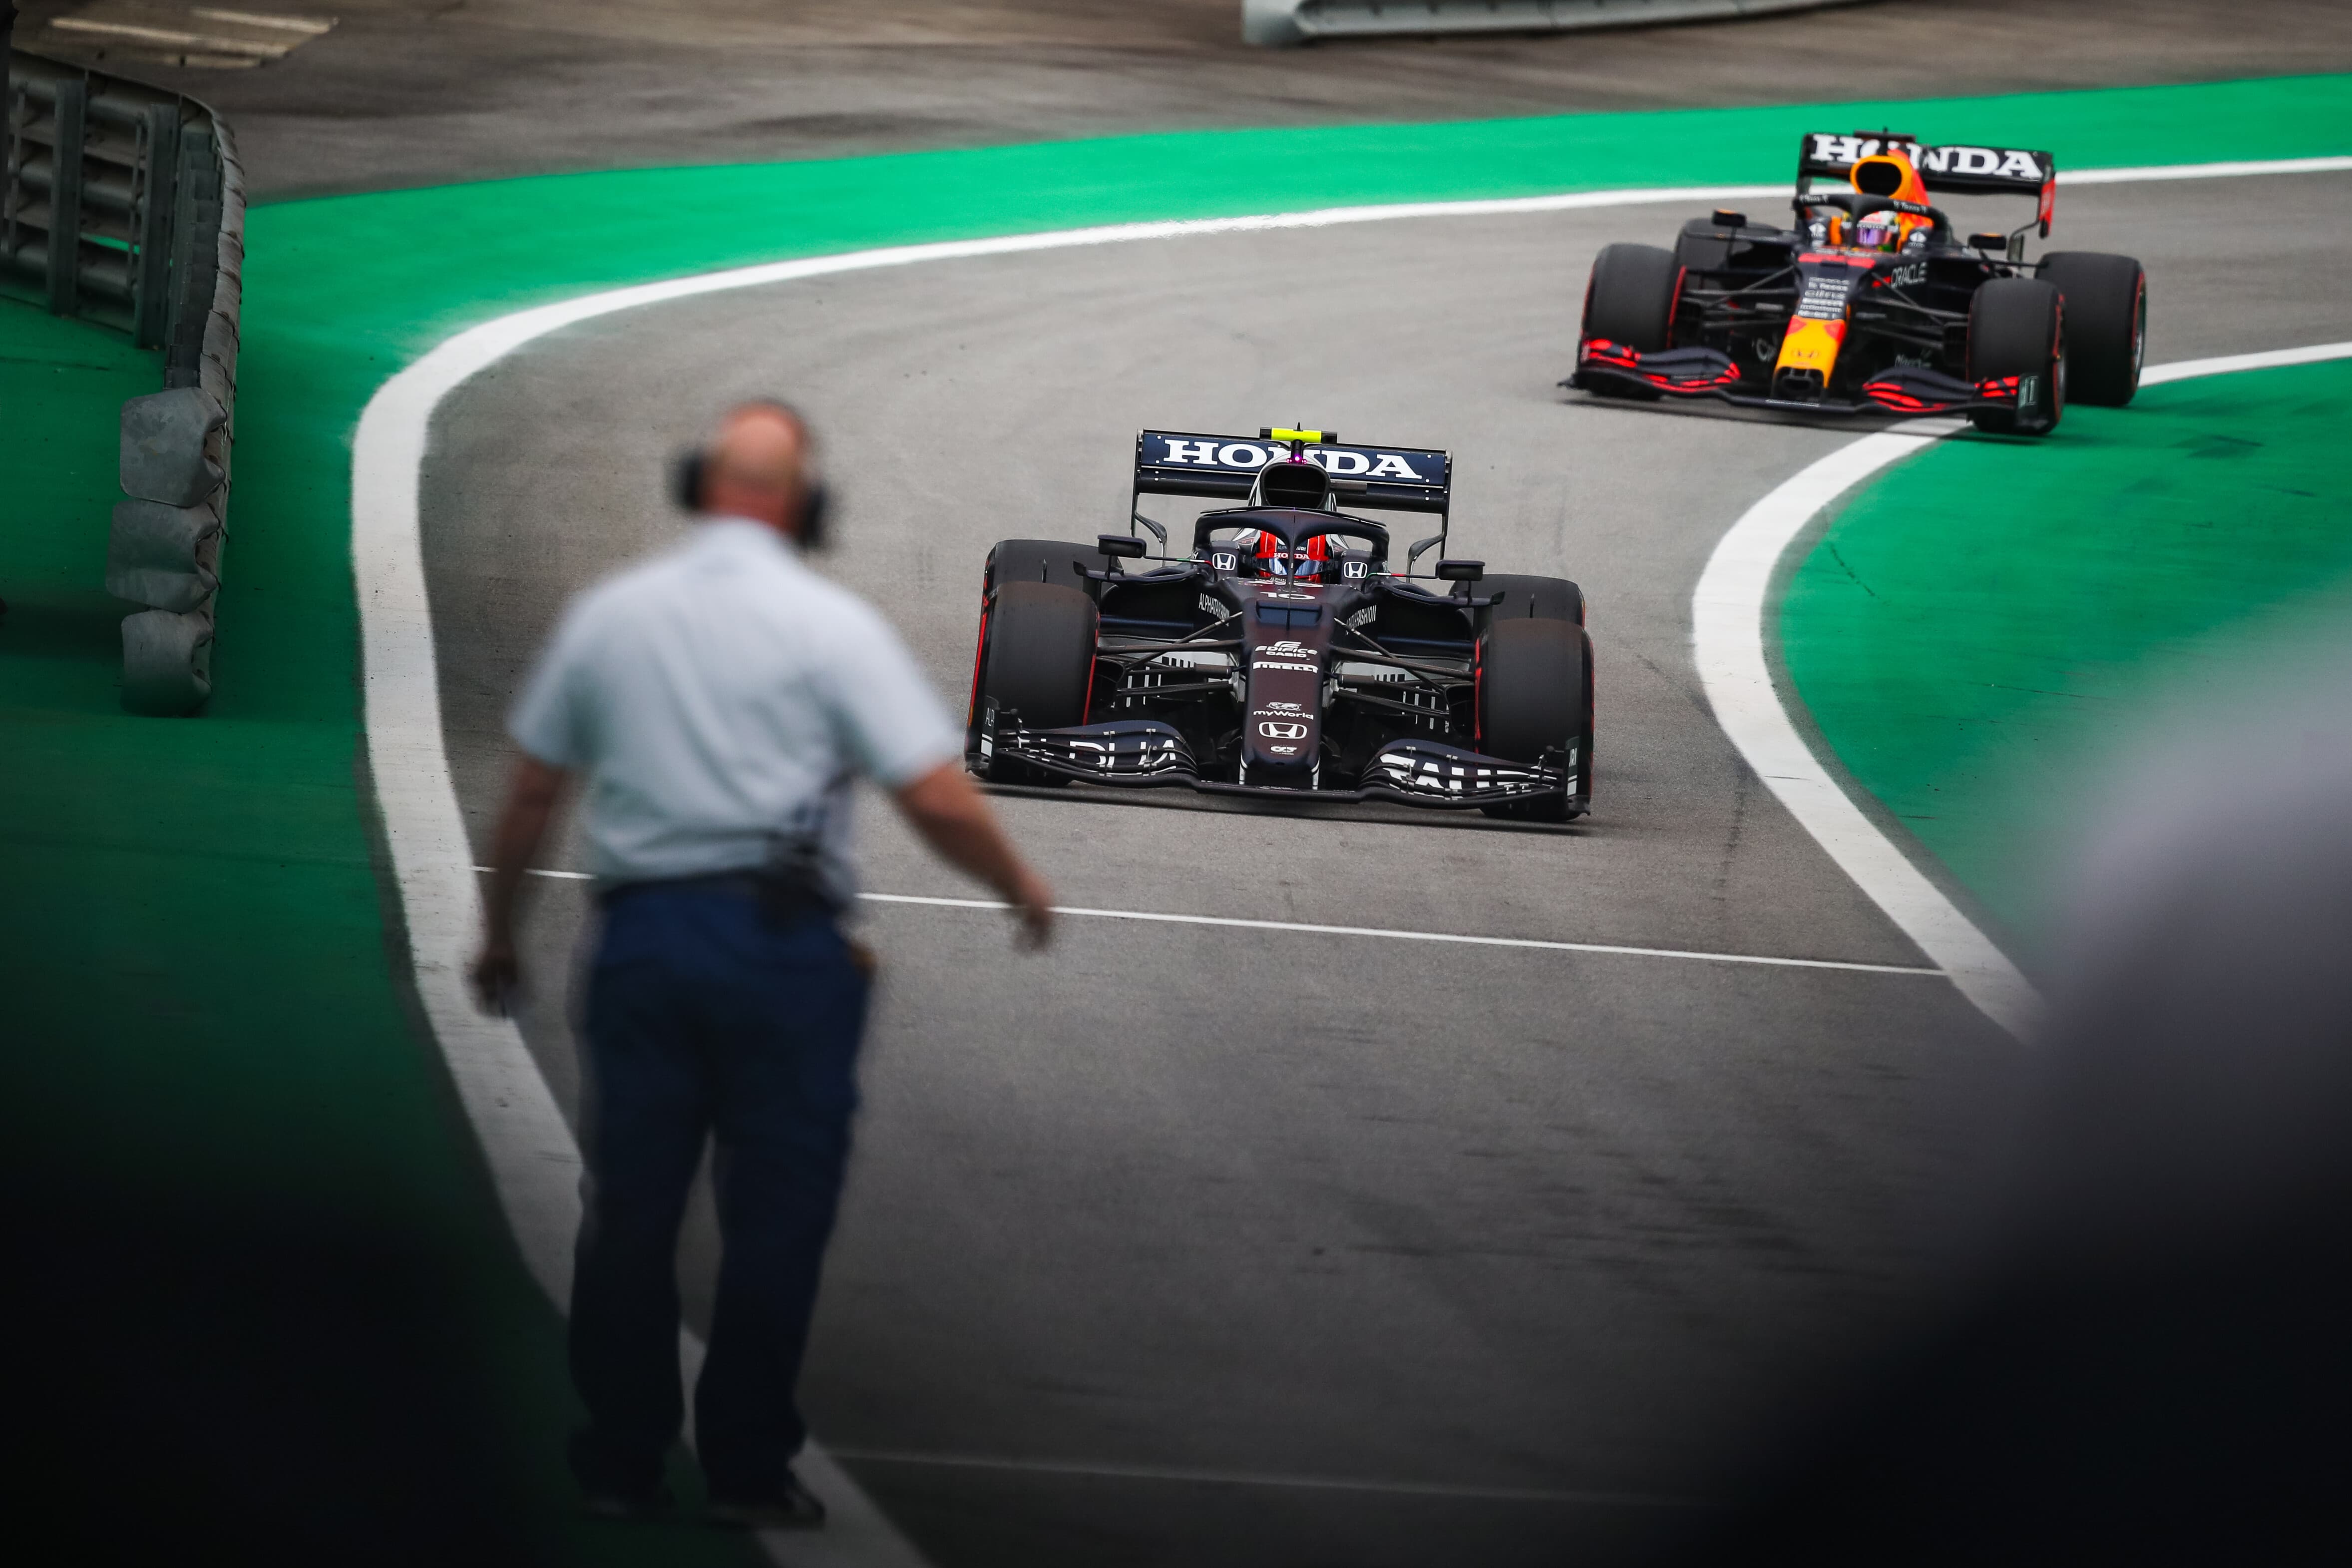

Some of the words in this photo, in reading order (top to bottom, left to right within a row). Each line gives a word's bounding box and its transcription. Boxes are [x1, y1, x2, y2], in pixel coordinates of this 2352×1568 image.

[1891, 262, 1927, 288] ORACLE
[1164, 439, 1422, 479] HODA
[1255, 646, 1318, 655] EDIFICE
[1253, 661, 1318, 673] PIRELLI
[1253, 711, 1314, 720] myWorld
